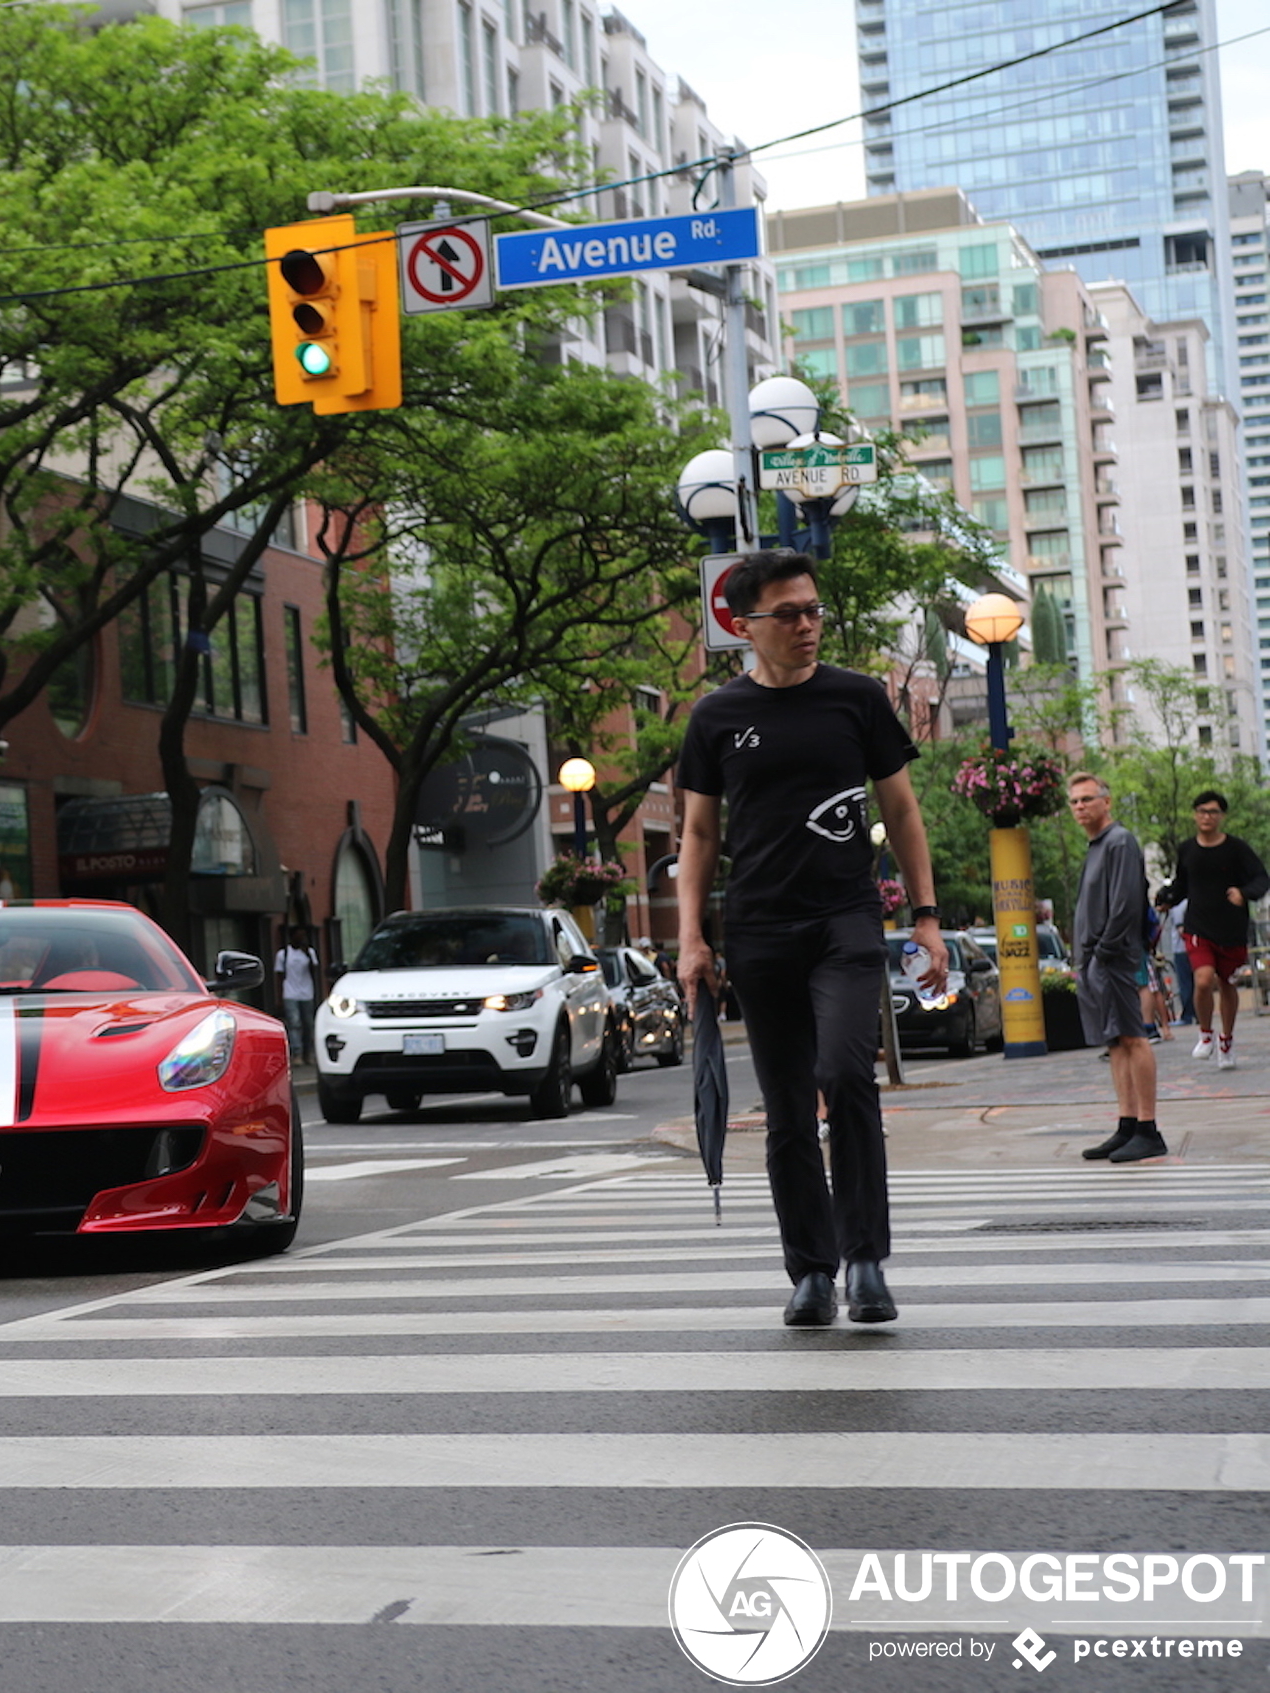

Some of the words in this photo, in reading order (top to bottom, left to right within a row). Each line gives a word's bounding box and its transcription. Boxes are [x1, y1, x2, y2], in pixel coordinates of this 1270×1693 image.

[538, 231, 678, 273] Avenue
[690, 219, 716, 240] Rd
[776, 469, 828, 485] AVENUE
[90, 855, 136, 870] POSTO
